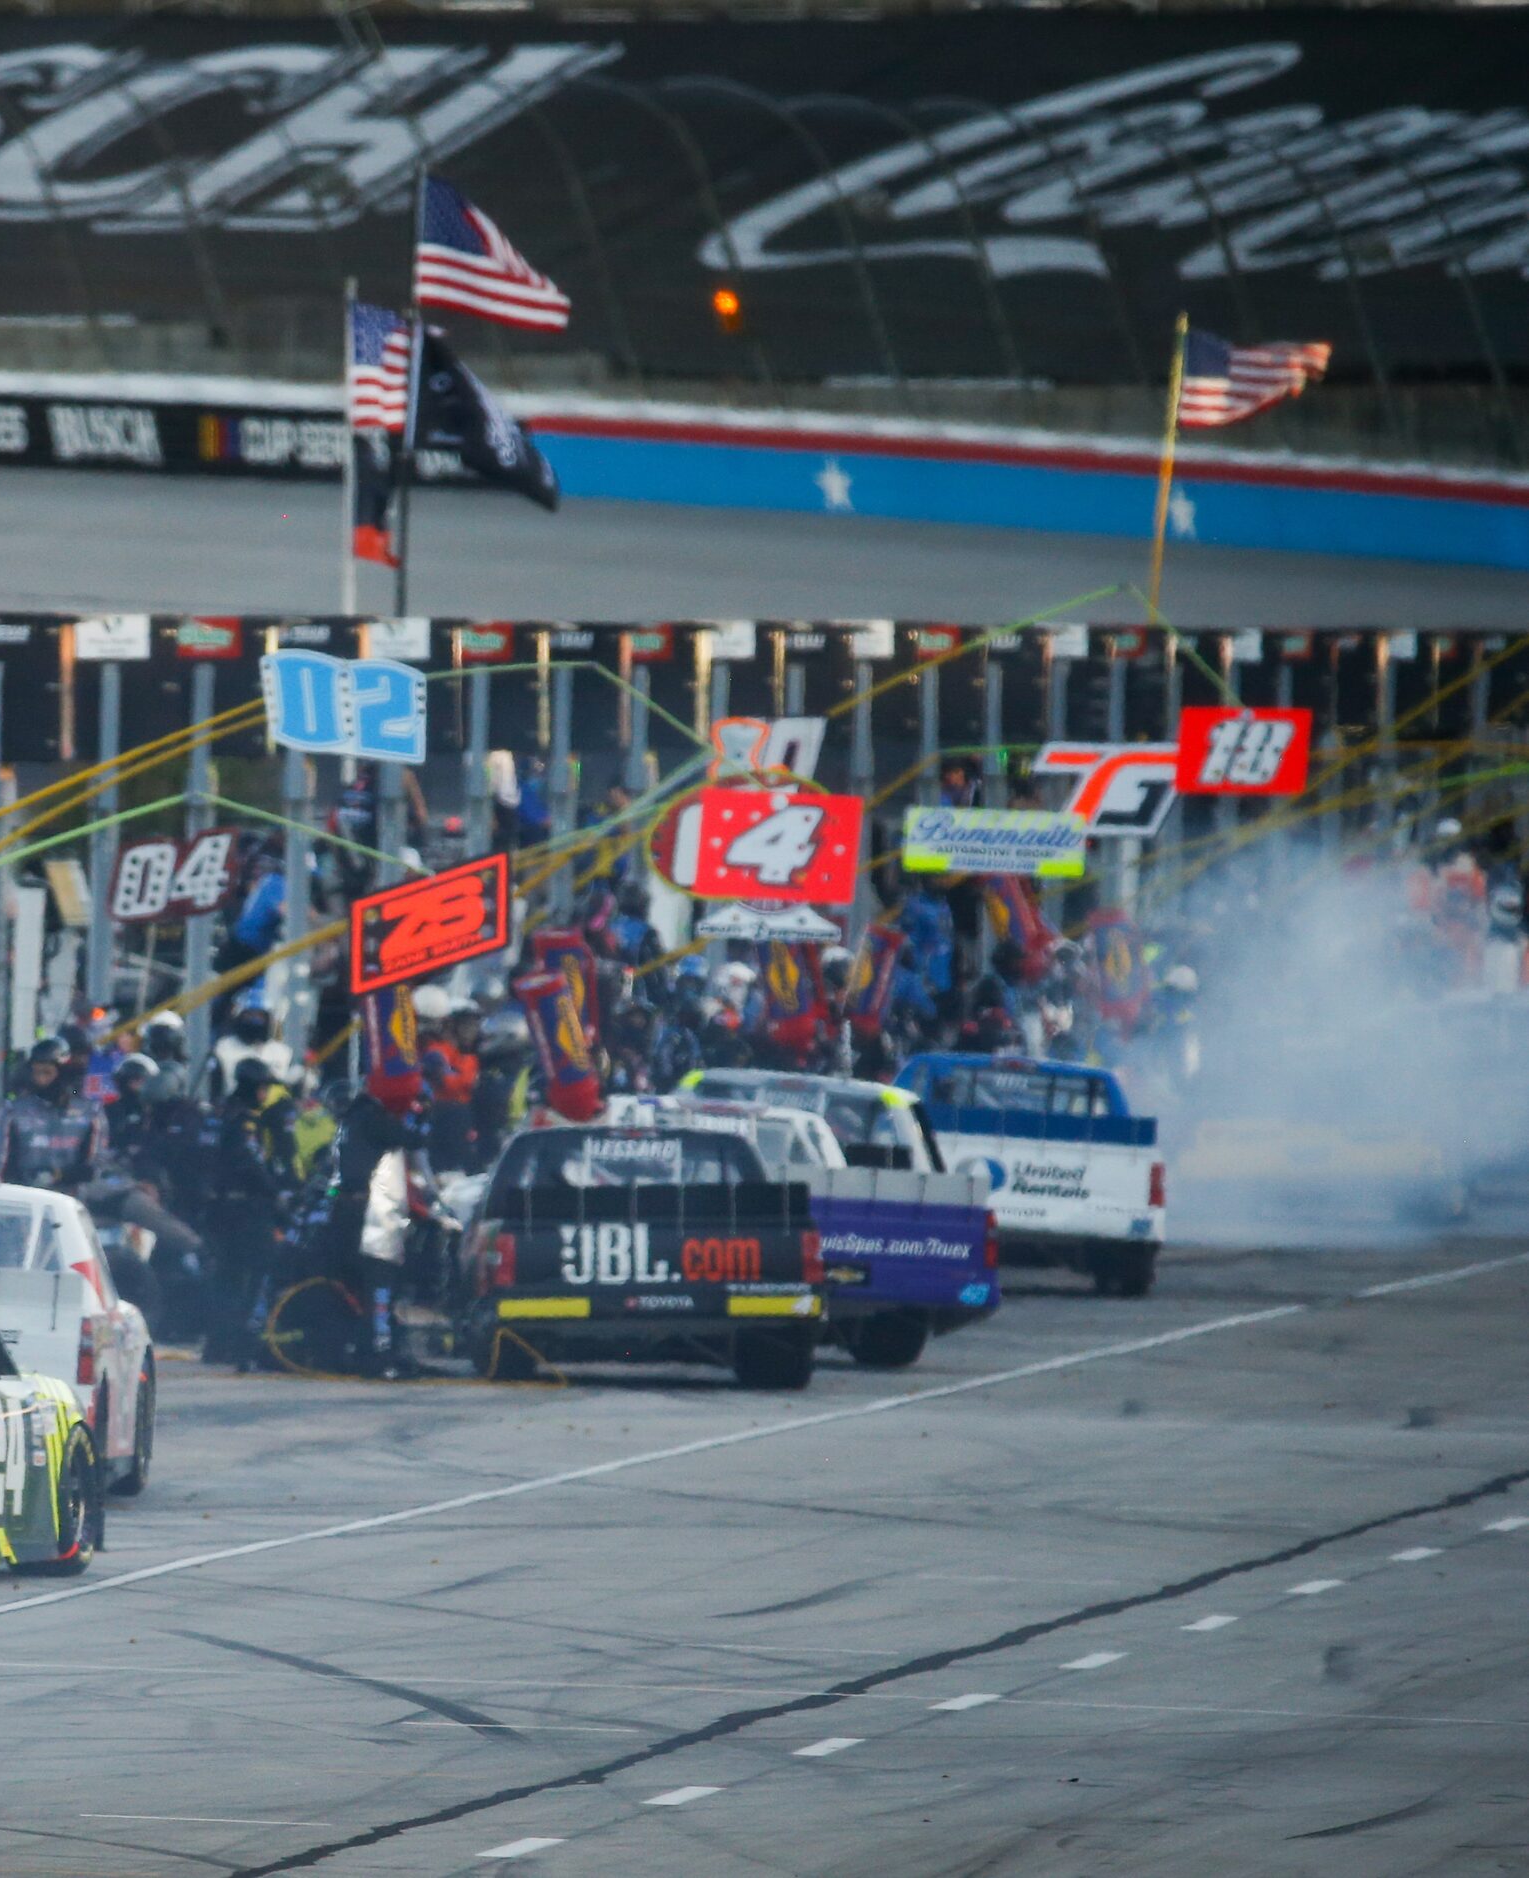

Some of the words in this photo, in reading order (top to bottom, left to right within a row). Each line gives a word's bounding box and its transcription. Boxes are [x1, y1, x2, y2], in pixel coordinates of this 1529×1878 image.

[269, 655, 424, 761] 02
[724, 804, 824, 886] 4
[112, 833, 231, 917] 04
[1012, 1179, 1090, 1199] Rentals
[1014, 1160, 1088, 1181] United
[640, 1295, 694, 1308] TOYOTA
